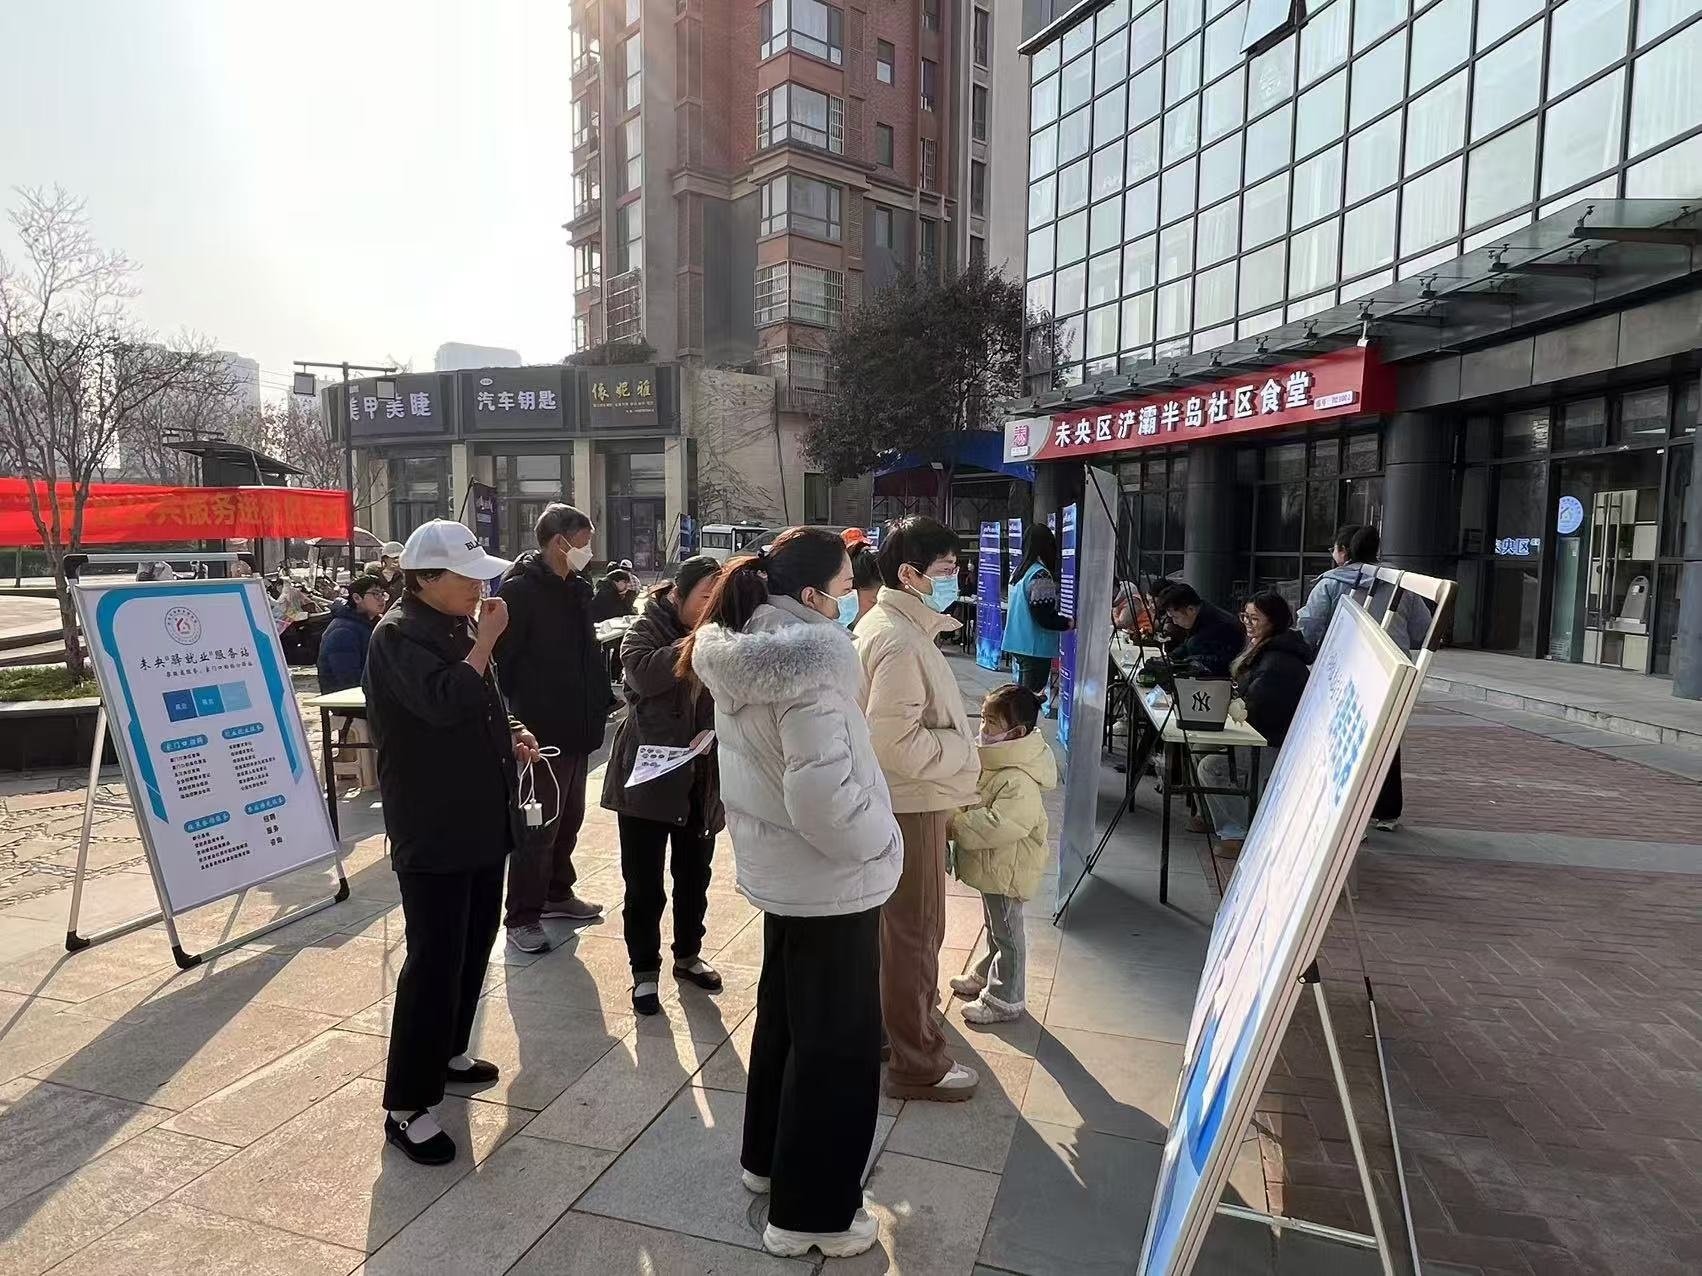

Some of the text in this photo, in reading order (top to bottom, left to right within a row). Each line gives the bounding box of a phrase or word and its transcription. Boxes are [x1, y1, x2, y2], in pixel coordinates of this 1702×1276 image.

[477, 389, 557, 411] 汽车钥匙
[1054, 370, 1312, 448] 未央区浐灞半岛社区食堂
[1191, 690, 1211, 713] NY
